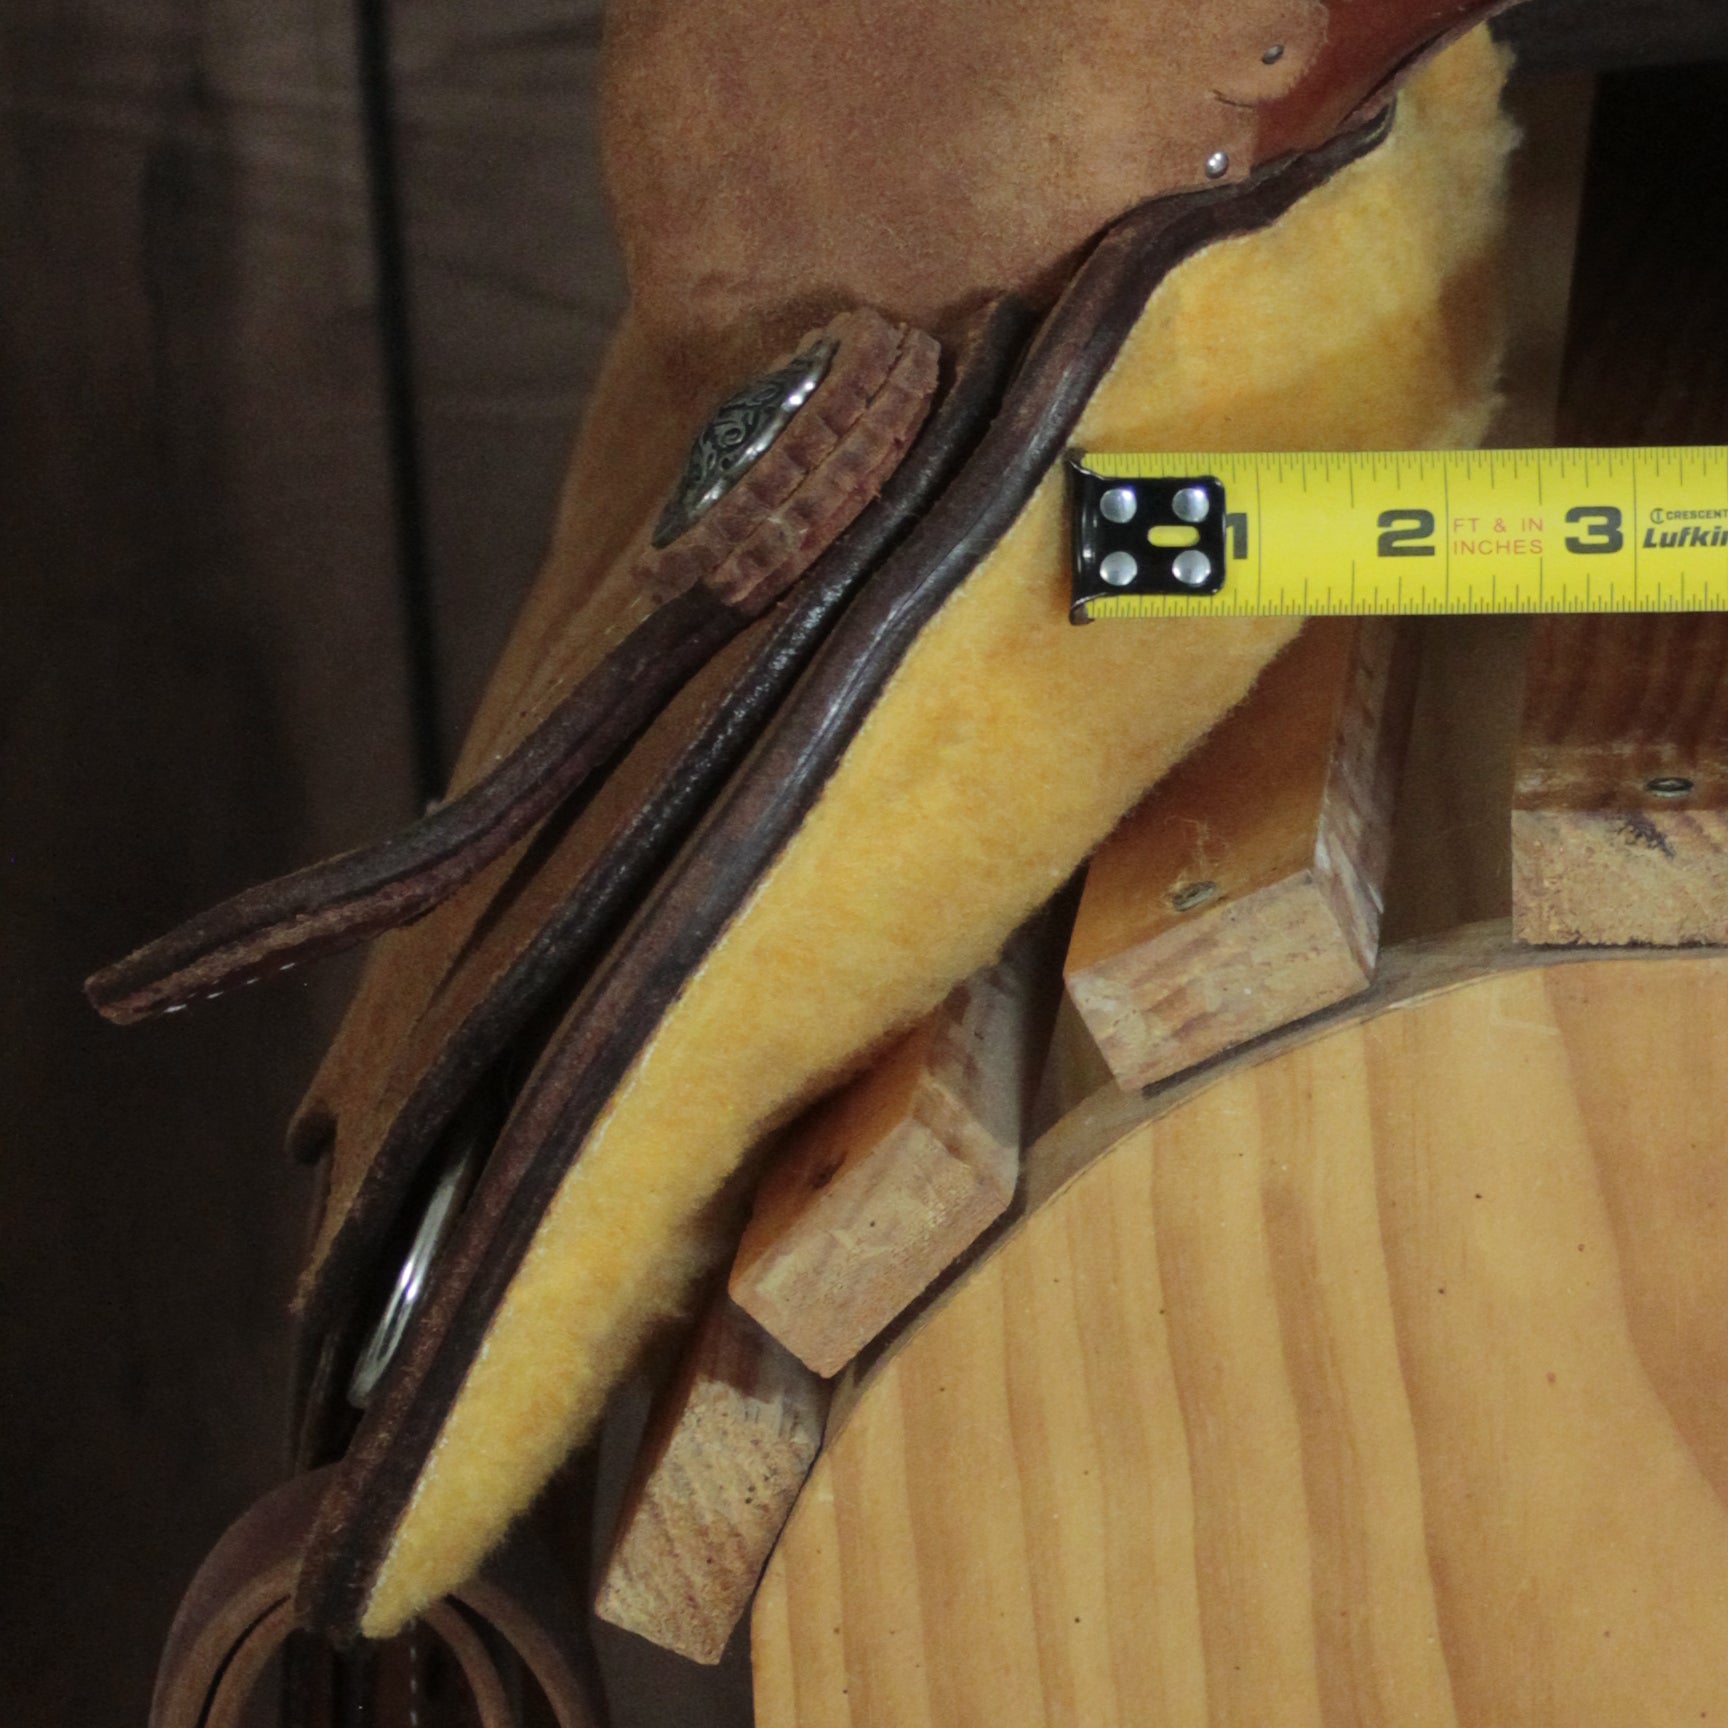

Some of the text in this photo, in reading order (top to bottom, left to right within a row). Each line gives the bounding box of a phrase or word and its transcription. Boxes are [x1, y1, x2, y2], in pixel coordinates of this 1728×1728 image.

[1453, 518, 1543, 533] FT & IN
[1565, 506, 1624, 553] 3
[1666, 509, 1728, 520] CRESCENT
[1225, 512, 1248, 559] 1
[1377, 510, 1435, 557] 2
[1453, 540, 1543, 555] INCHES
